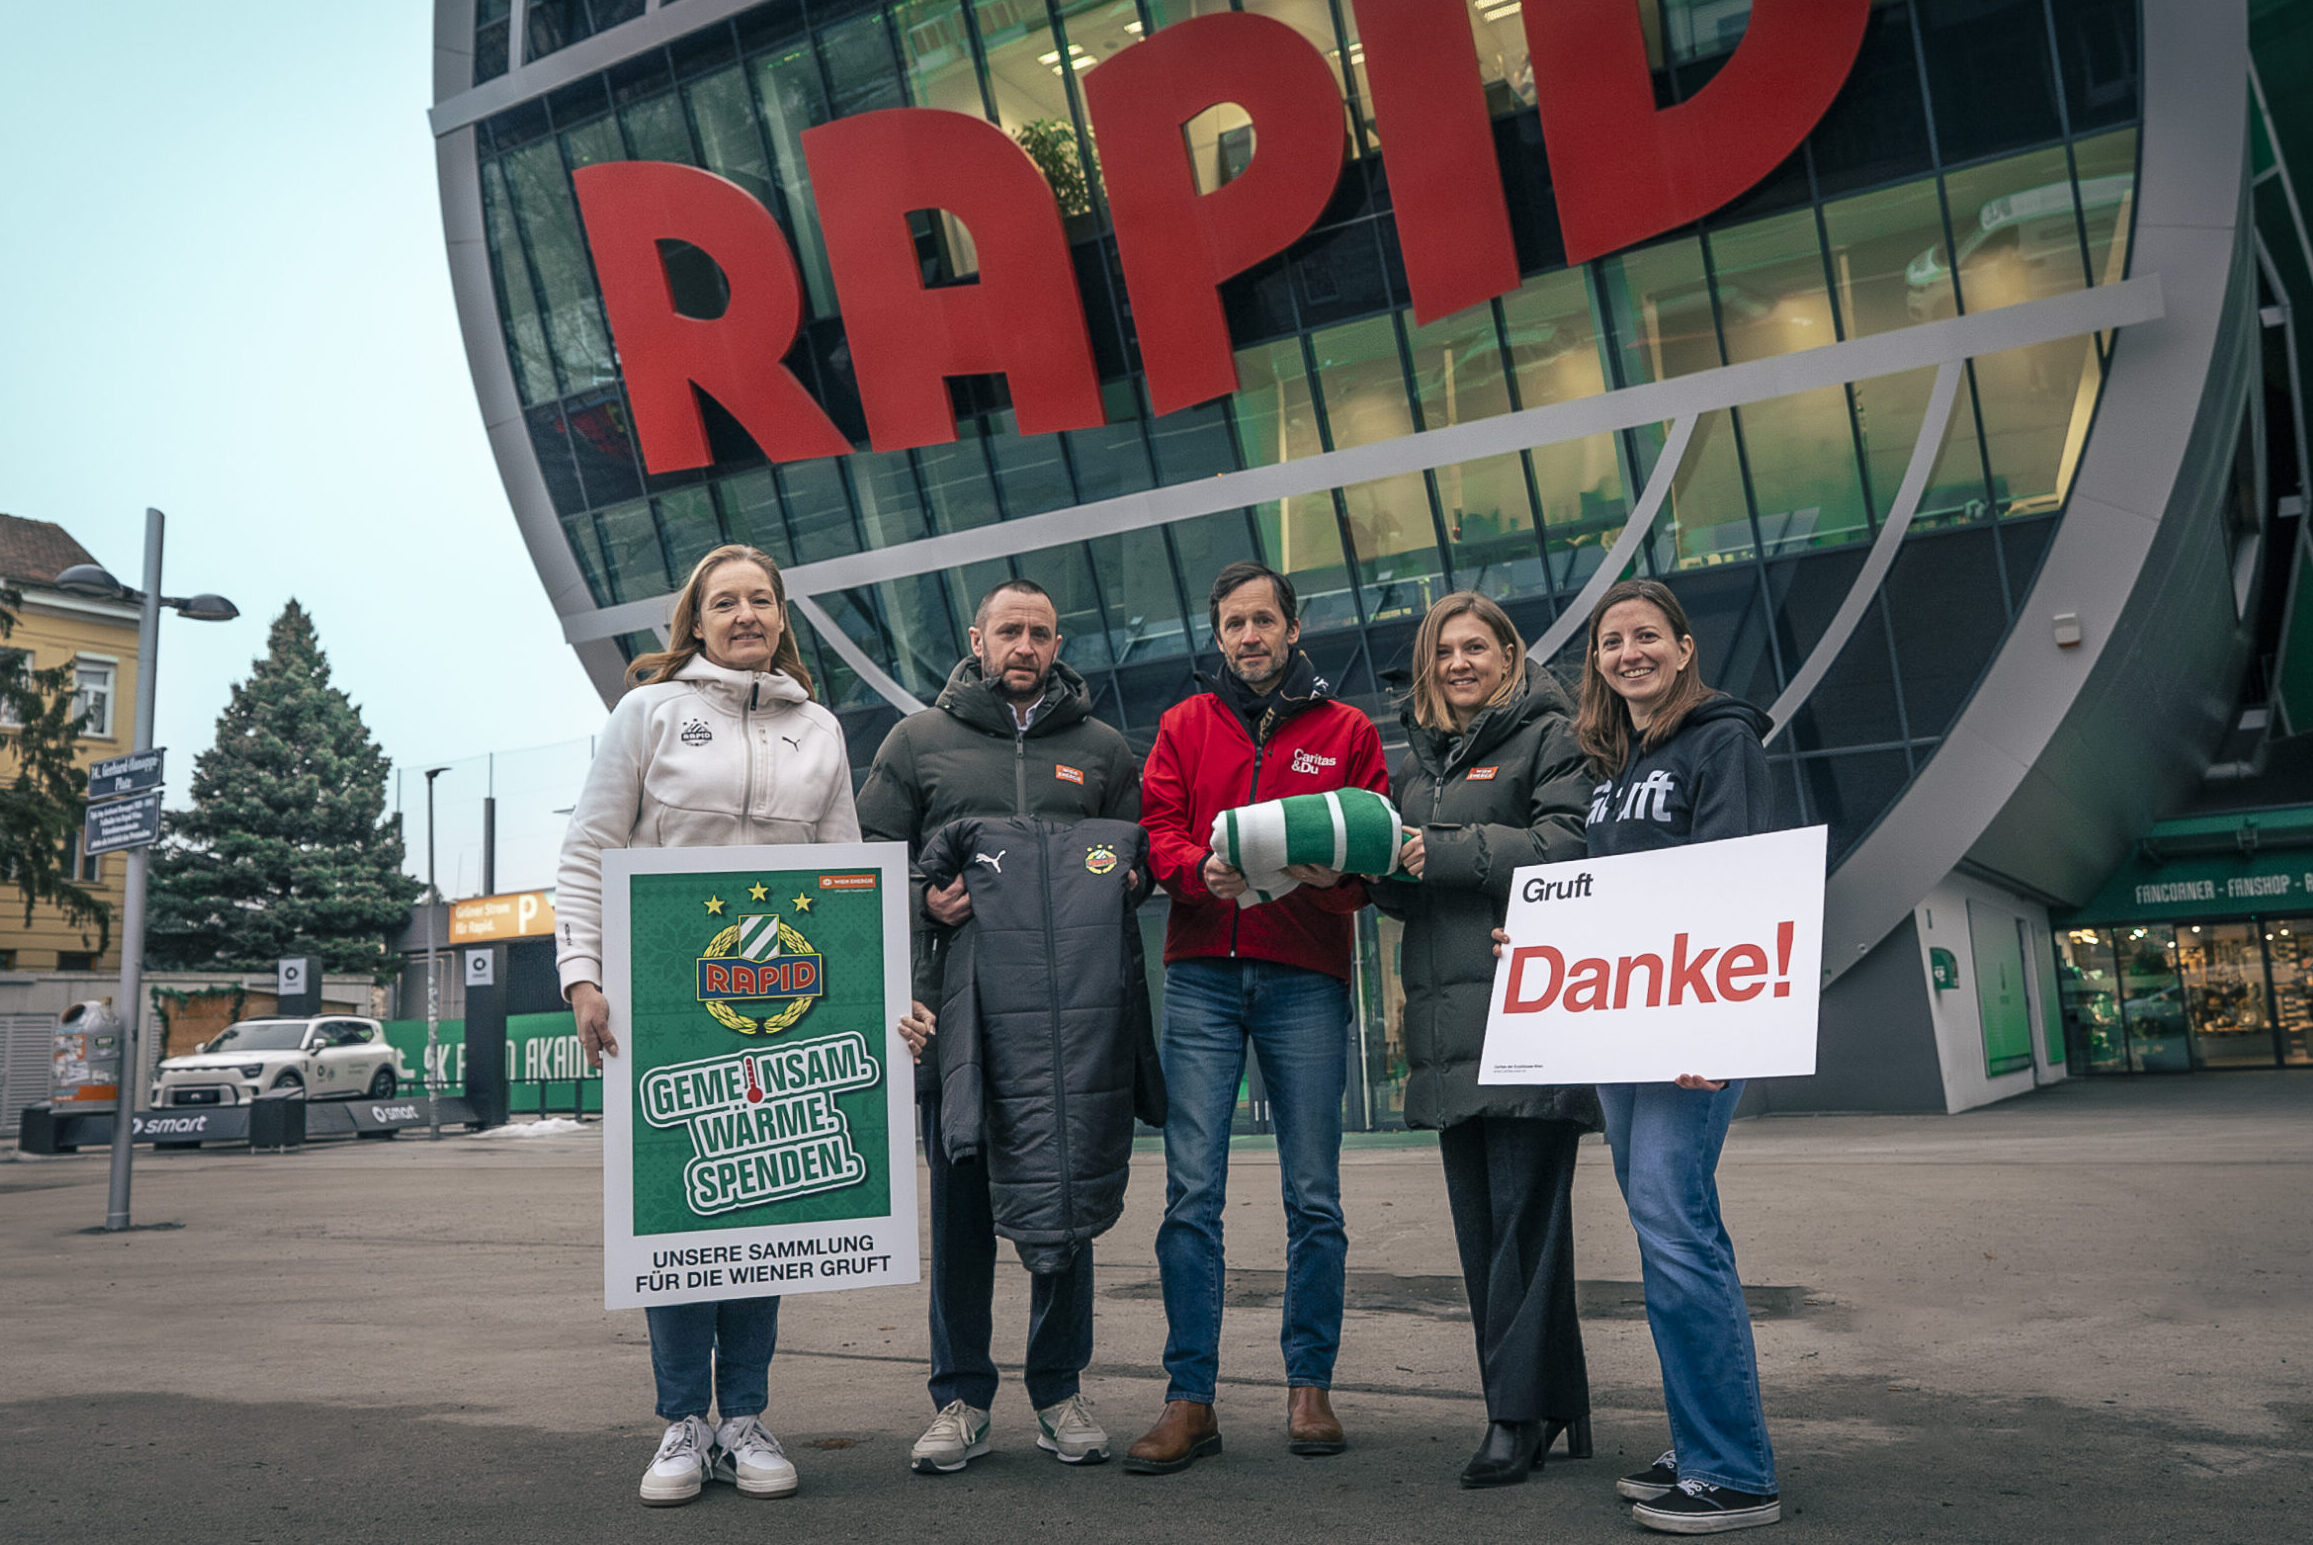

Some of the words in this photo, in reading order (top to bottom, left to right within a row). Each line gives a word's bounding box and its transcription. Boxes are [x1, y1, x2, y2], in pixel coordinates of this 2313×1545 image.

[572, 0, 1871, 476] RAPID
[1291, 760, 1319, 775] &Du
[1294, 748, 1336, 766] Caritas
[1522, 872, 1594, 903] Gruft
[2135, 880, 2216, 905] FANCORNER
[2227, 874, 2291, 898] FANSHOP
[518, 894, 538, 935] P
[706, 961, 816, 995] RAPID
[1503, 921, 1795, 1014] Danke!
[144, 1116, 208, 1134] smart
[384, 1105, 419, 1120] smart
[700, 1097, 835, 1152] WÄRME.
[697, 1141, 853, 1203] SPENDEN.
[653, 1245, 742, 1268] UNSERE
[748, 1235, 874, 1260] SAMMLUNG
[636, 1271, 680, 1293] FÜR
[687, 1269, 723, 1288] DIE
[730, 1262, 814, 1284] WIENER
[820, 1255, 891, 1276] GRUFT
